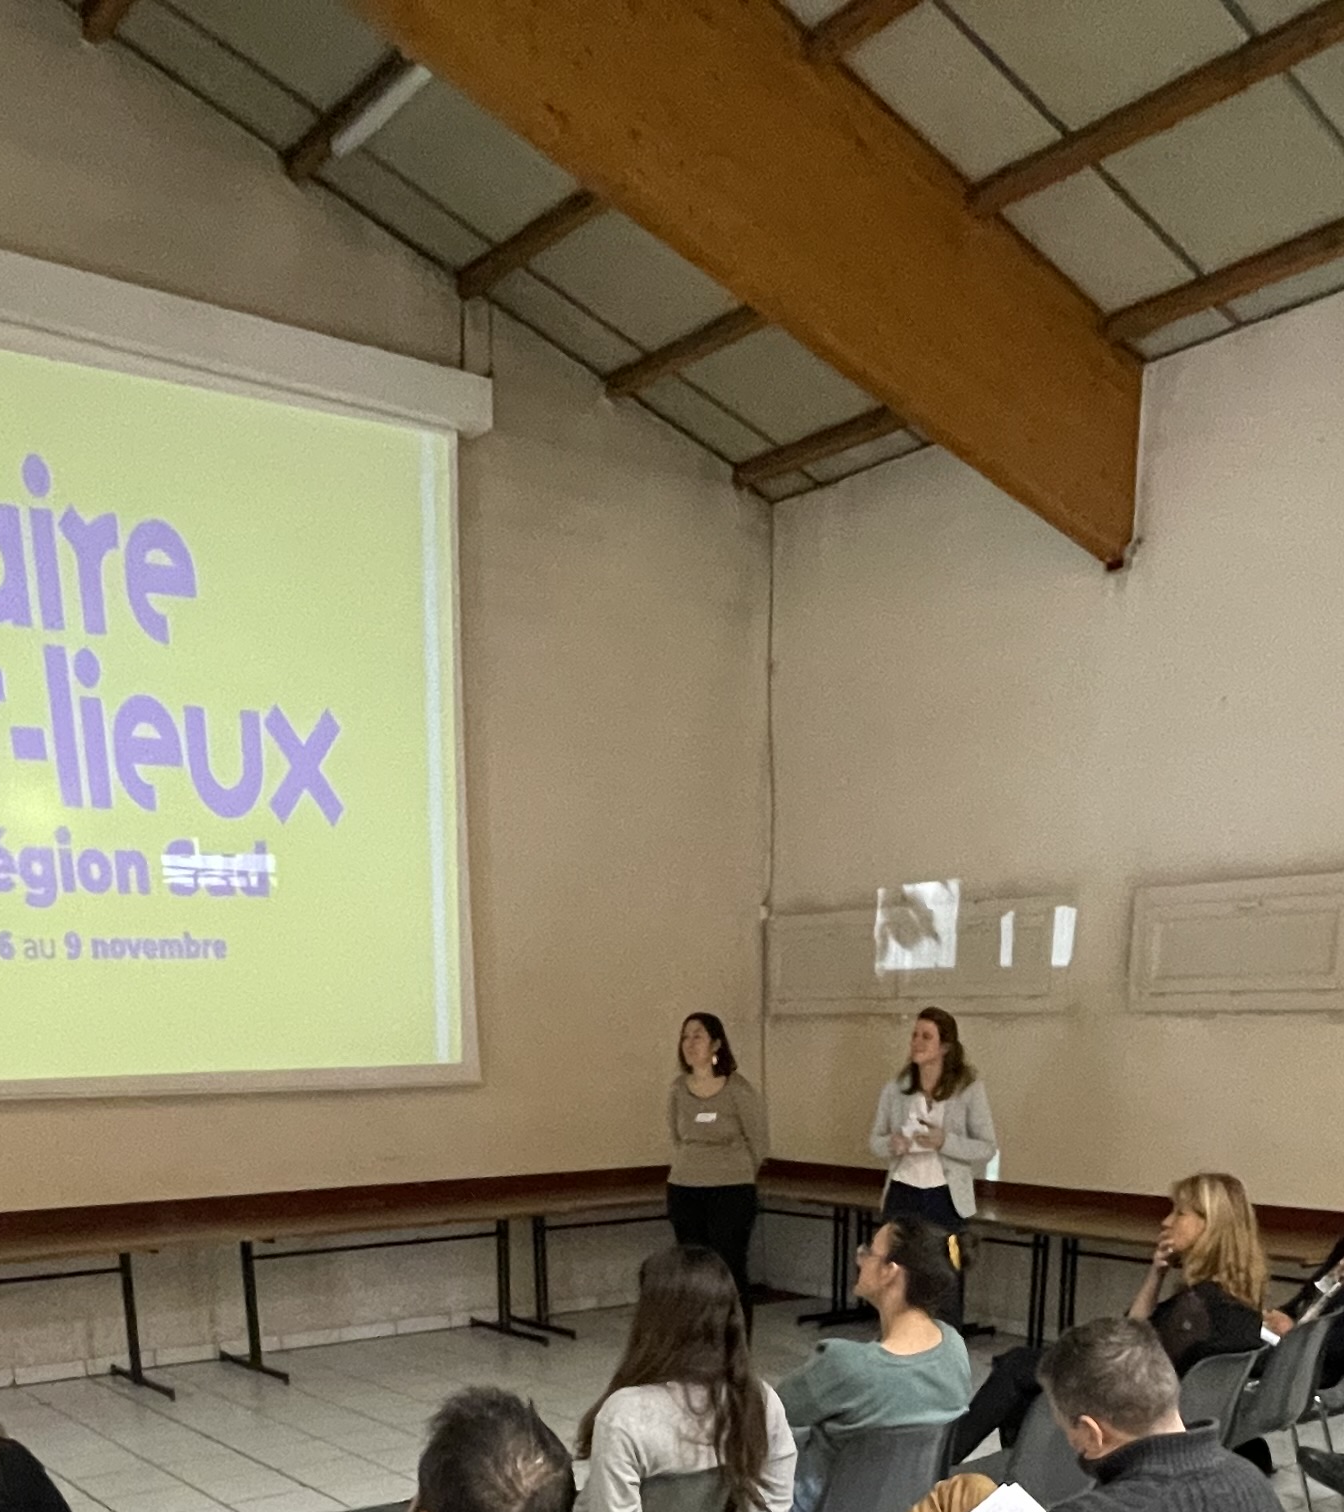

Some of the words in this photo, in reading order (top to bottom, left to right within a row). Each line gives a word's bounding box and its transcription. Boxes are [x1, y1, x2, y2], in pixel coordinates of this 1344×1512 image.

[23, 937, 56, 960] au
[63, 930, 83, 960] 9
[90, 931, 228, 961] novembre
